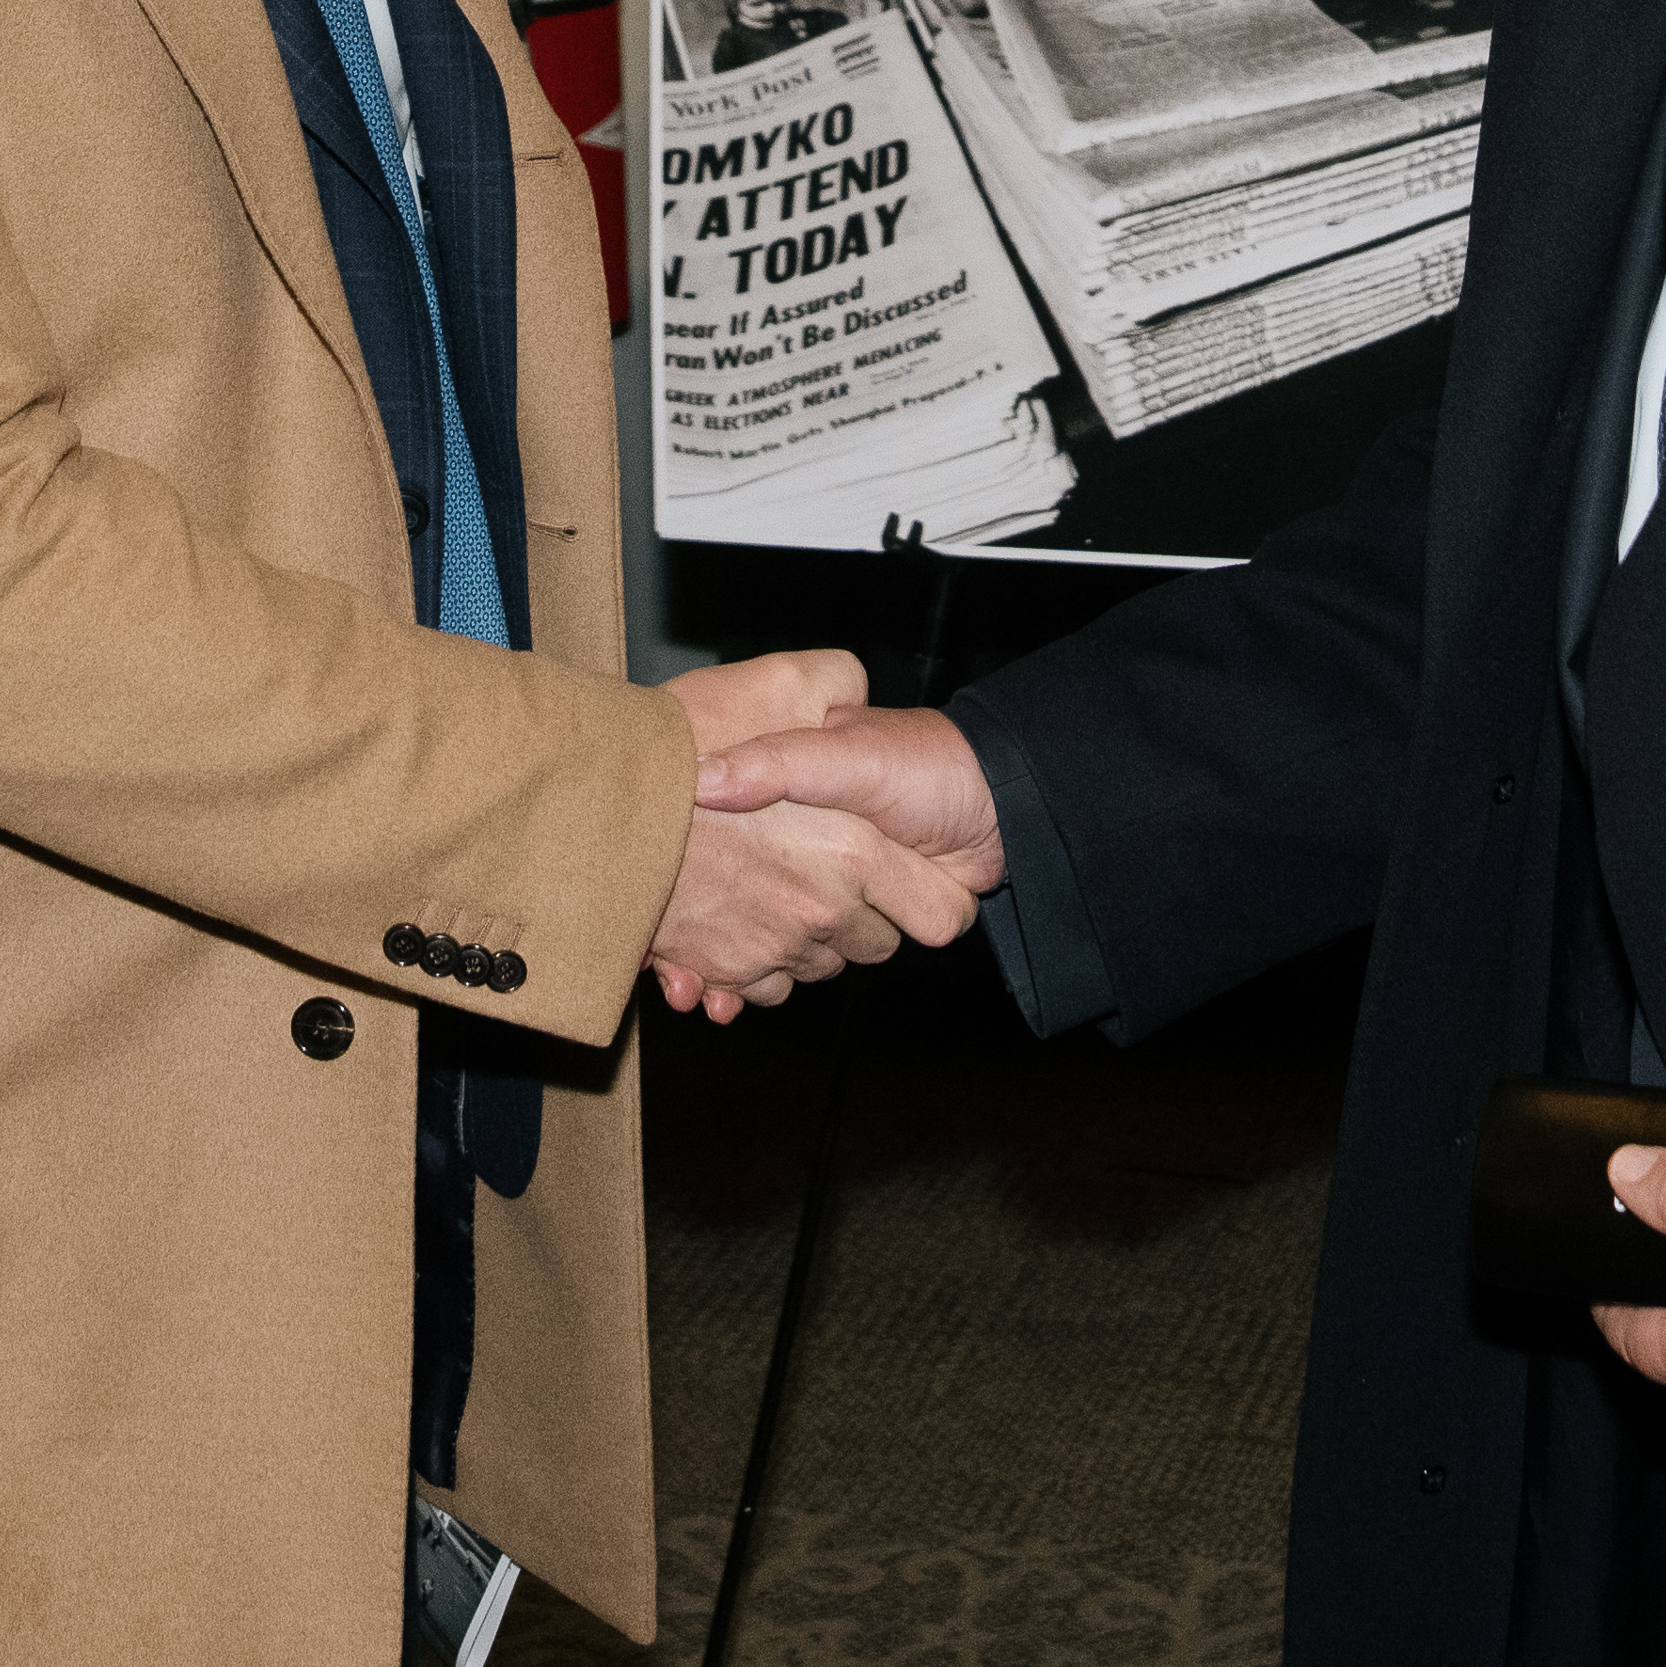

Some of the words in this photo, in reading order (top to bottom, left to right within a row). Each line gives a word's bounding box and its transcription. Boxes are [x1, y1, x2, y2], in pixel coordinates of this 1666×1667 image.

[669, 94, 739, 118] York
[751, 67, 813, 101] Post
[695, 138, 909, 241] ATTEND
[728, 195, 909, 295] TODAY
[664, 353, 707, 371] ran
[712, 334, 794, 371] Won't
[802, 324, 836, 350] Be
[844, 268, 967, 336] Discussed
[730, 310, 751, 336] If
[759, 275, 865, 329] Assured
[727, 360, 844, 407] ATMOSPHERE
[853, 327, 942, 371] MENACING
[670, 412, 694, 428] AS
[704, 400, 792, 432] ELECTIONS
[802, 382, 851, 409] NEAR
[829, 403, 897, 430] Shanghai
